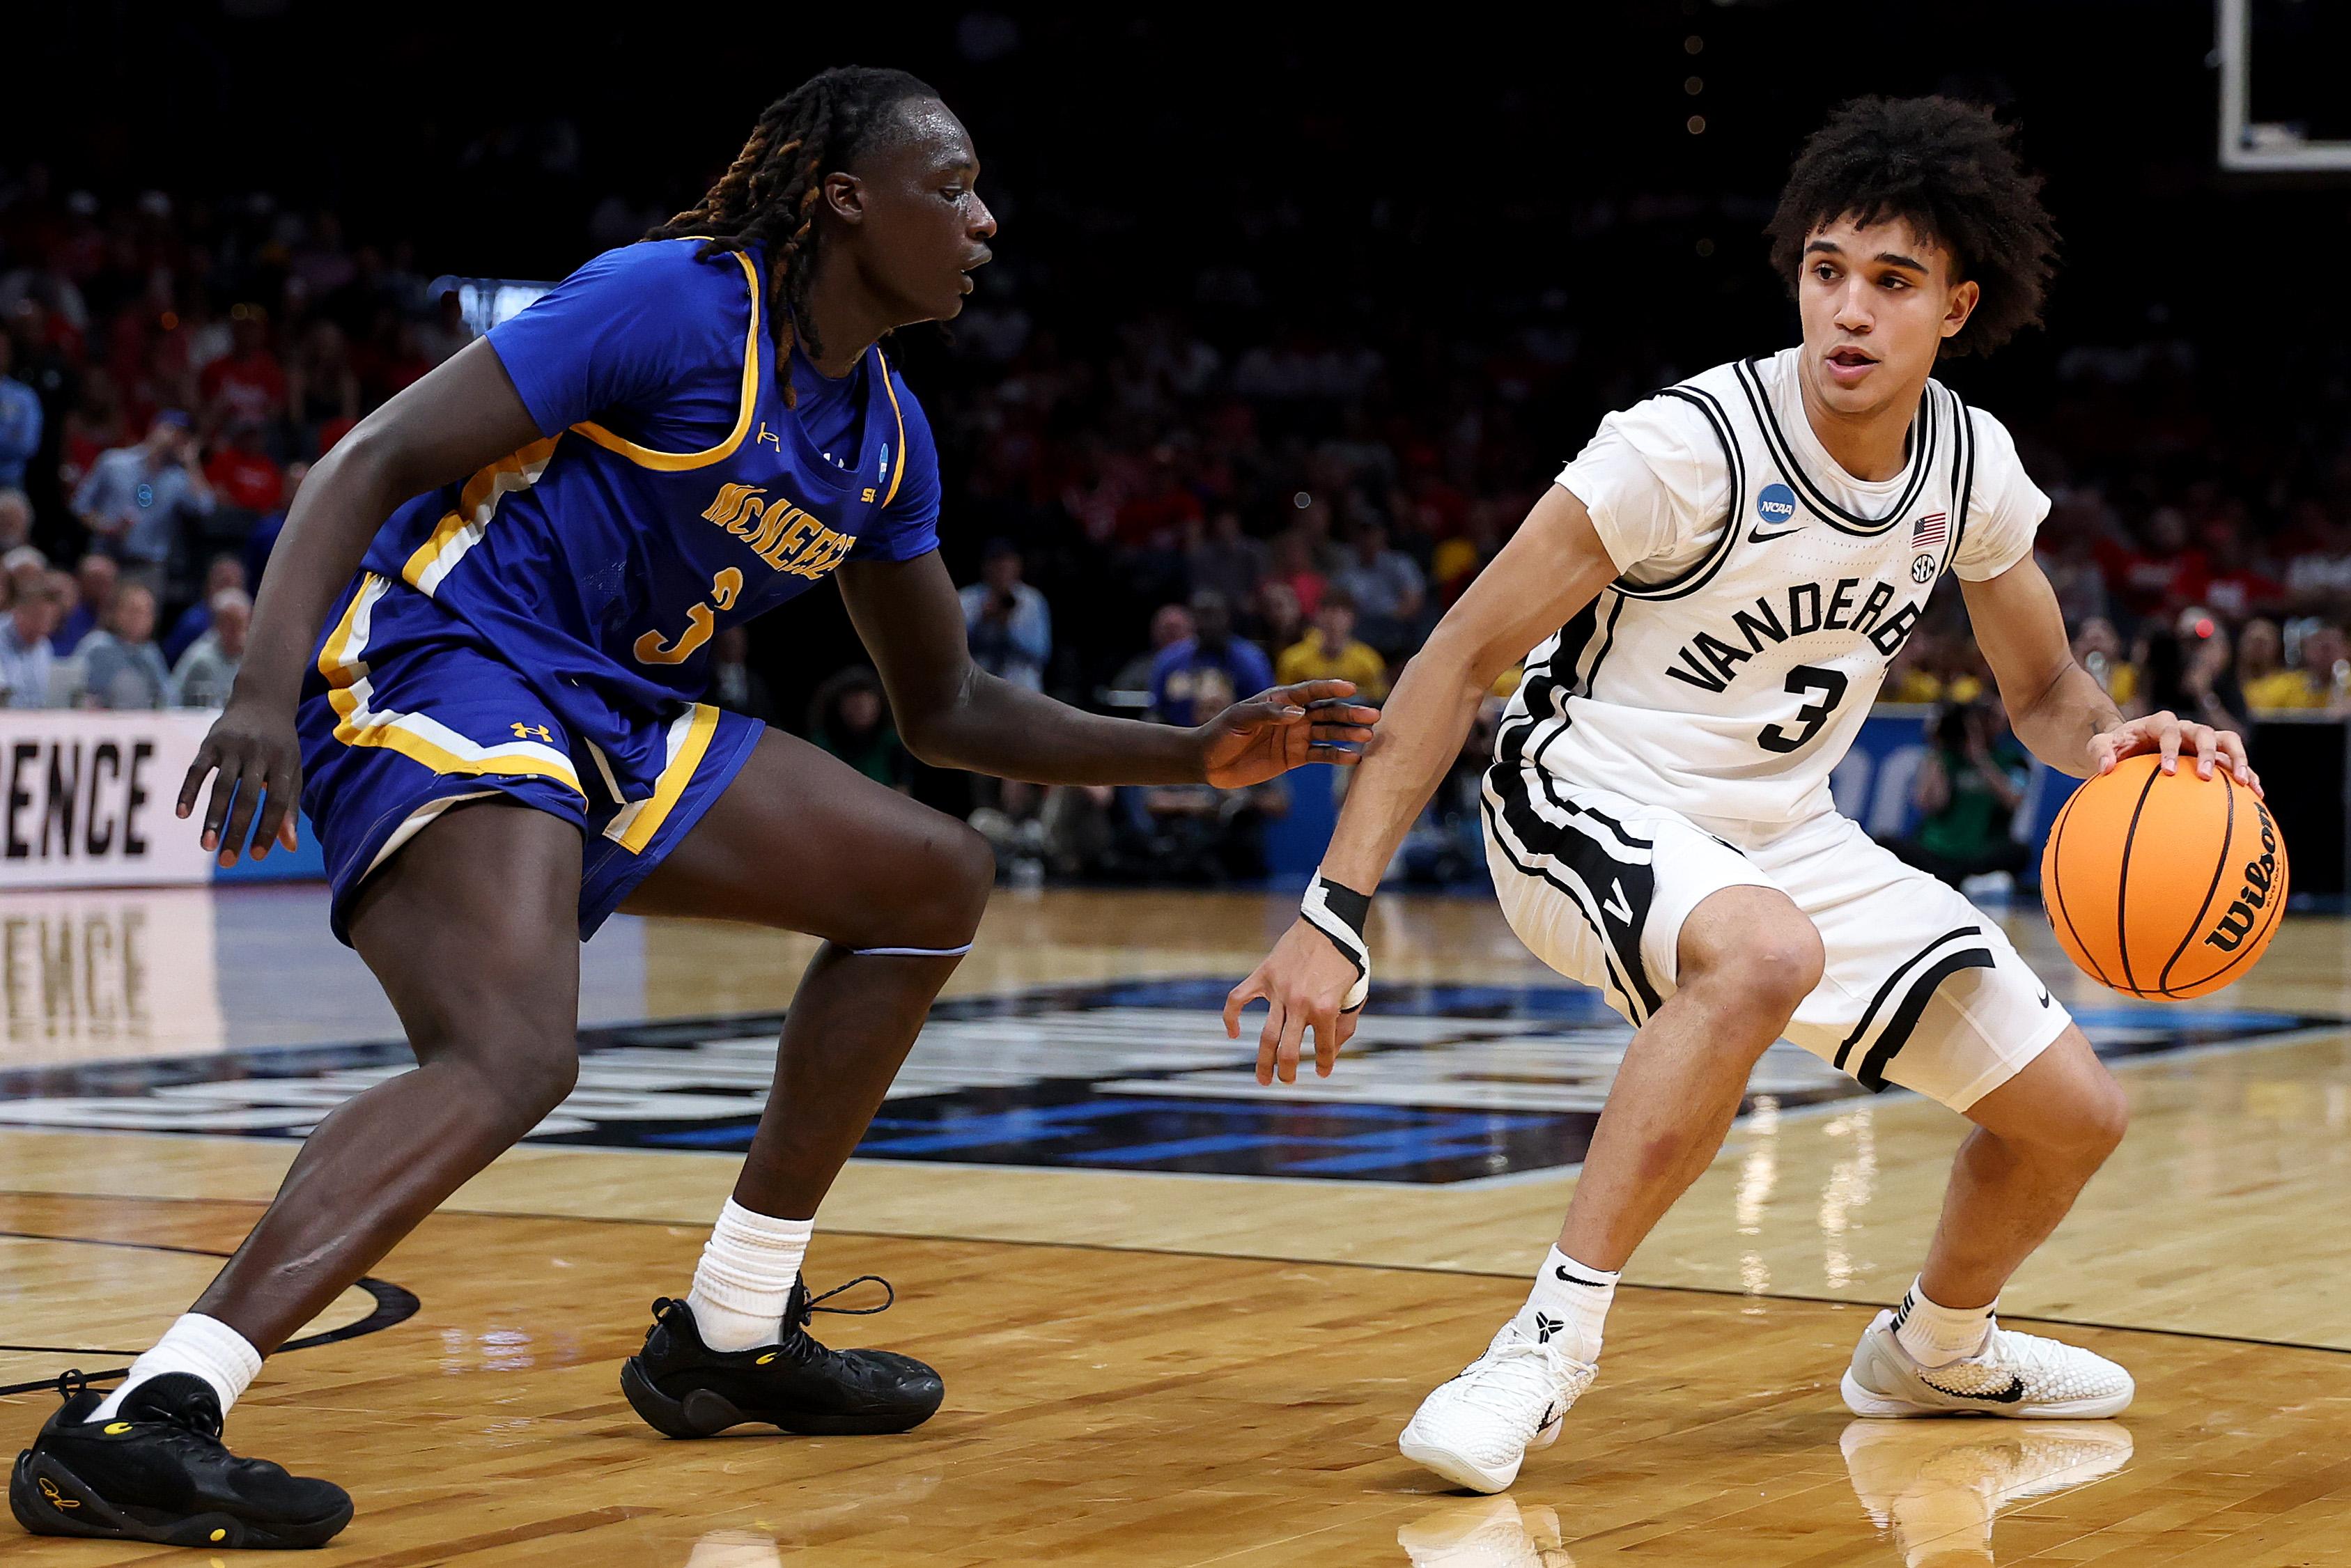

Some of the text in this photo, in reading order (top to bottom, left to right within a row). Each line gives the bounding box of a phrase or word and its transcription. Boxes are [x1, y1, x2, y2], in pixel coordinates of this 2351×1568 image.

[1761, 501, 1793, 515] NCAA
[633, 566, 744, 665] 3
[1912, 555, 1934, 582] SEC
[1757, 664, 1849, 754] 3
[6, 743, 153, 859] ENCE
[2204, 802, 2276, 952] Wilson
